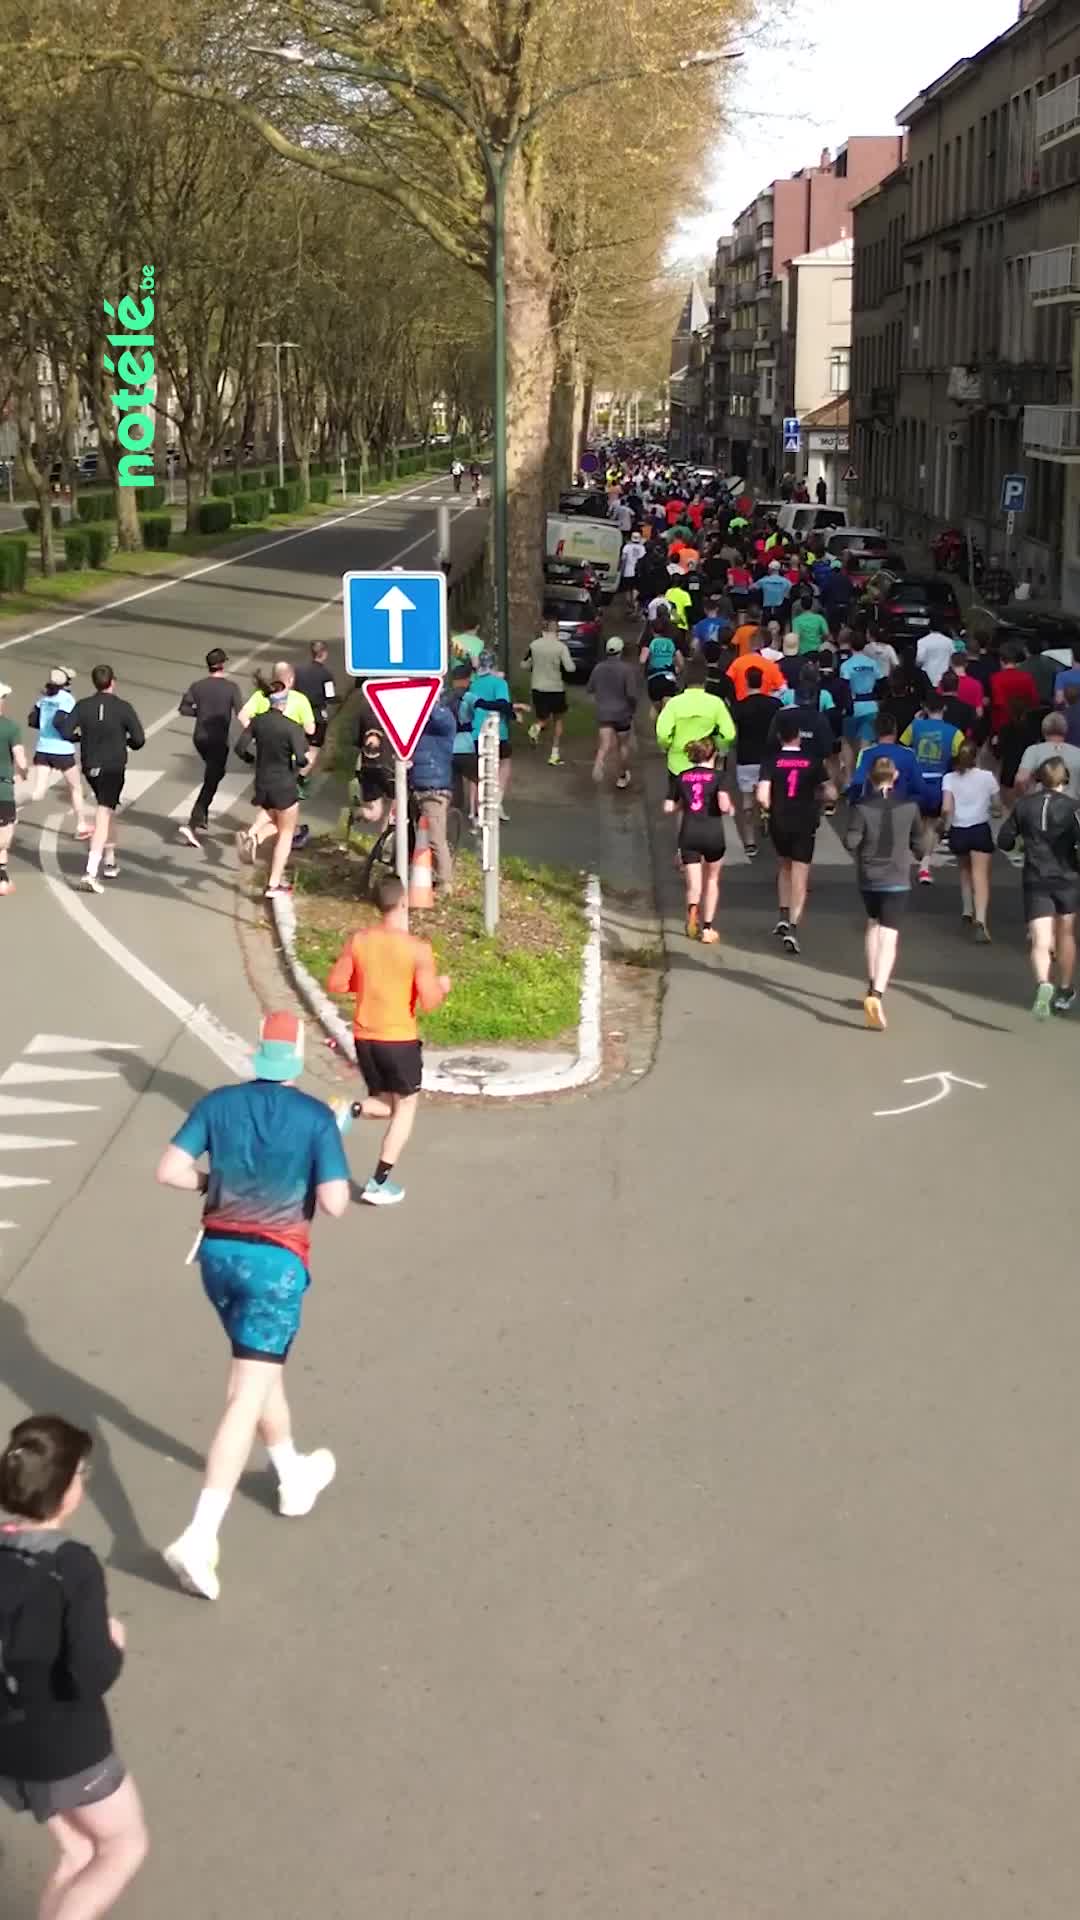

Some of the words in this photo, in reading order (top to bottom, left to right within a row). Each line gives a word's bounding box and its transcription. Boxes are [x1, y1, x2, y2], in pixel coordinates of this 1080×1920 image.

[1004, 480, 1023, 506] P
[689, 782, 704, 812] 3
[786, 769, 799, 798] 1
